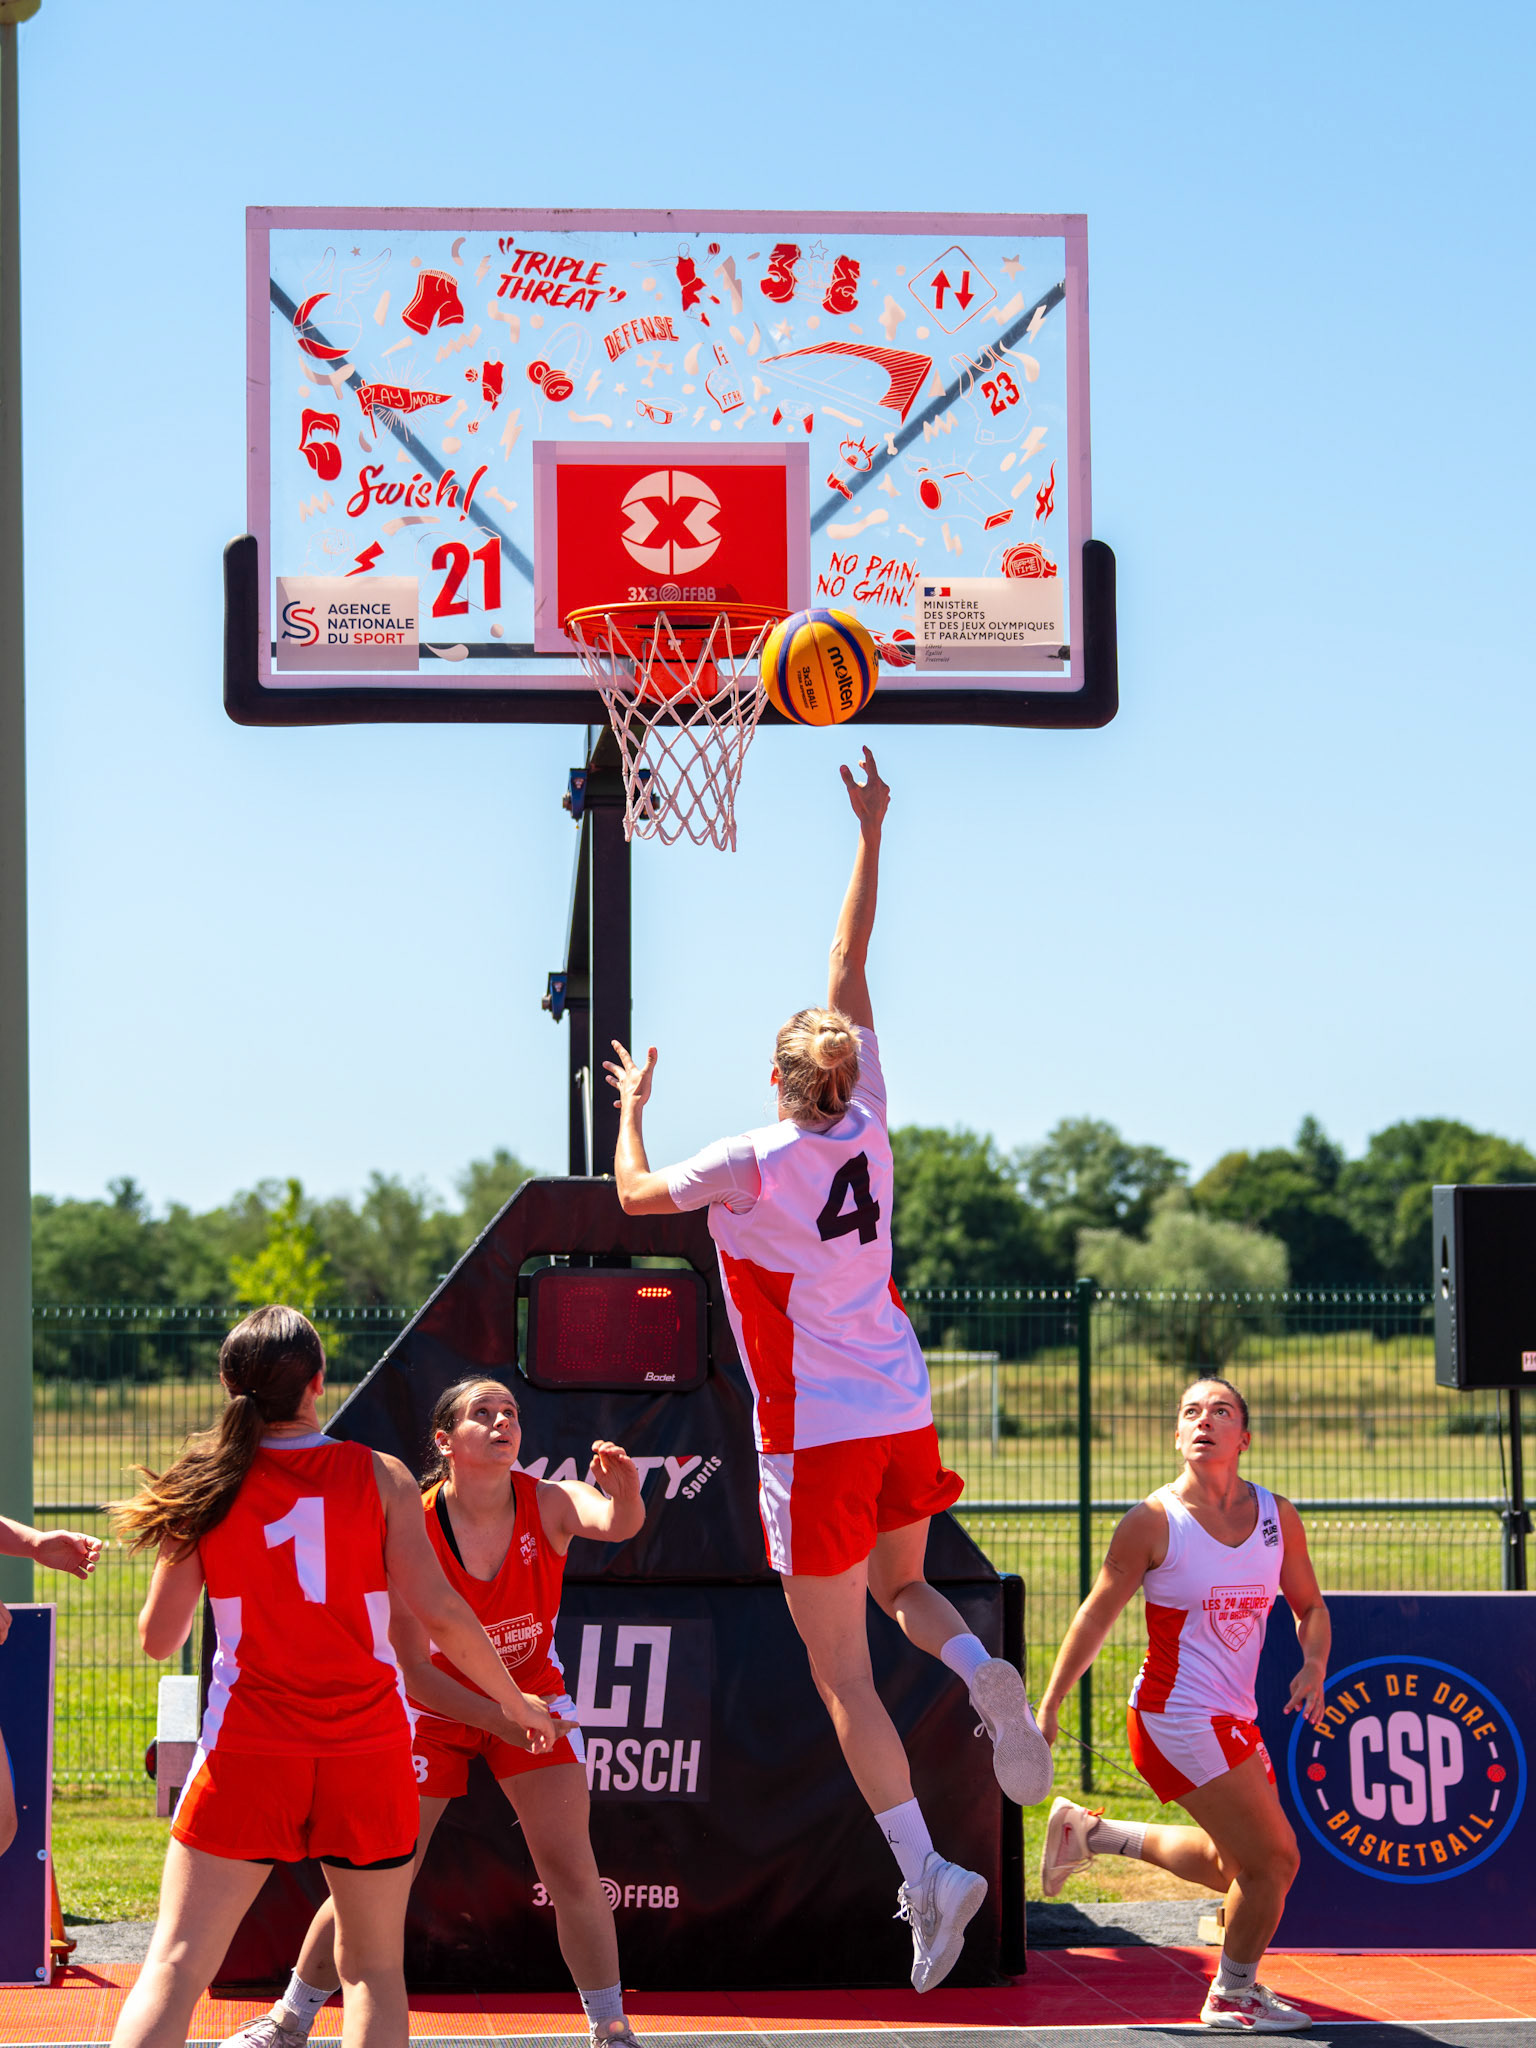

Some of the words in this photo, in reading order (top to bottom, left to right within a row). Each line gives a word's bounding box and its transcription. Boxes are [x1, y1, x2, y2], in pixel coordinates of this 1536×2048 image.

[603, 316, 680, 363] DEFENSE
[361, 386, 405, 407] PLAY
[413, 395, 441, 410] MORE
[981, 371, 1021, 417] 23
[346, 464, 489, 522] Swish!
[829, 550, 859, 576] NO
[1013, 558, 1035, 568] GAME
[1015, 564, 1038, 574] TIME
[431, 537, 501, 618] 21
[628, 586, 658, 601] 3X3
[682, 586, 716, 601] FFBB
[816, 573, 846, 597] NO
[853, 578, 915, 608] GAIN!
[328, 603, 391, 615] AGENCE
[923, 599, 979, 609] MINISTÈRE
[924, 611, 943, 620] DES
[946, 611, 985, 620] SPORTS
[328, 618, 415, 629] NATIONALE
[924, 621, 936, 630] ET
[939, 621, 959, 630] DES
[961, 621, 986, 631] JEUX
[988, 621, 1055, 632] OLYMPIQUES
[328, 633, 349, 644] DU
[353, 632, 405, 644] SPORT
[924, 632, 936, 640] ET
[939, 631, 1025, 642] PARALYMPIQUES
[827, 646, 854, 711] molten
[806, 688, 819, 710] BALL
[816, 1151, 881, 1246] 4
[644, 1371, 676, 1382] Bodet
[681, 1455, 722, 1500] Sports
[263, 1496, 327, 1605] 1
[1202, 1599, 1221, 1611] LES
[1224, 1597, 1237, 1610] 24
[1238, 1596, 1269, 1609] HEURES
[1218, 1612, 1229, 1621] DU
[504, 1621, 543, 1644] HEURES
[1313, 1681, 1372, 1740] PONT
[1385, 1673, 1419, 1697] DE
[1432, 1681, 1498, 1741] DORE
[586, 1737, 701, 1793] RSCH
[1348, 1710, 1465, 1827] CSP
[1326, 1809, 1495, 1868] BASKETBALL
[624, 1884, 680, 1910] FFBB
